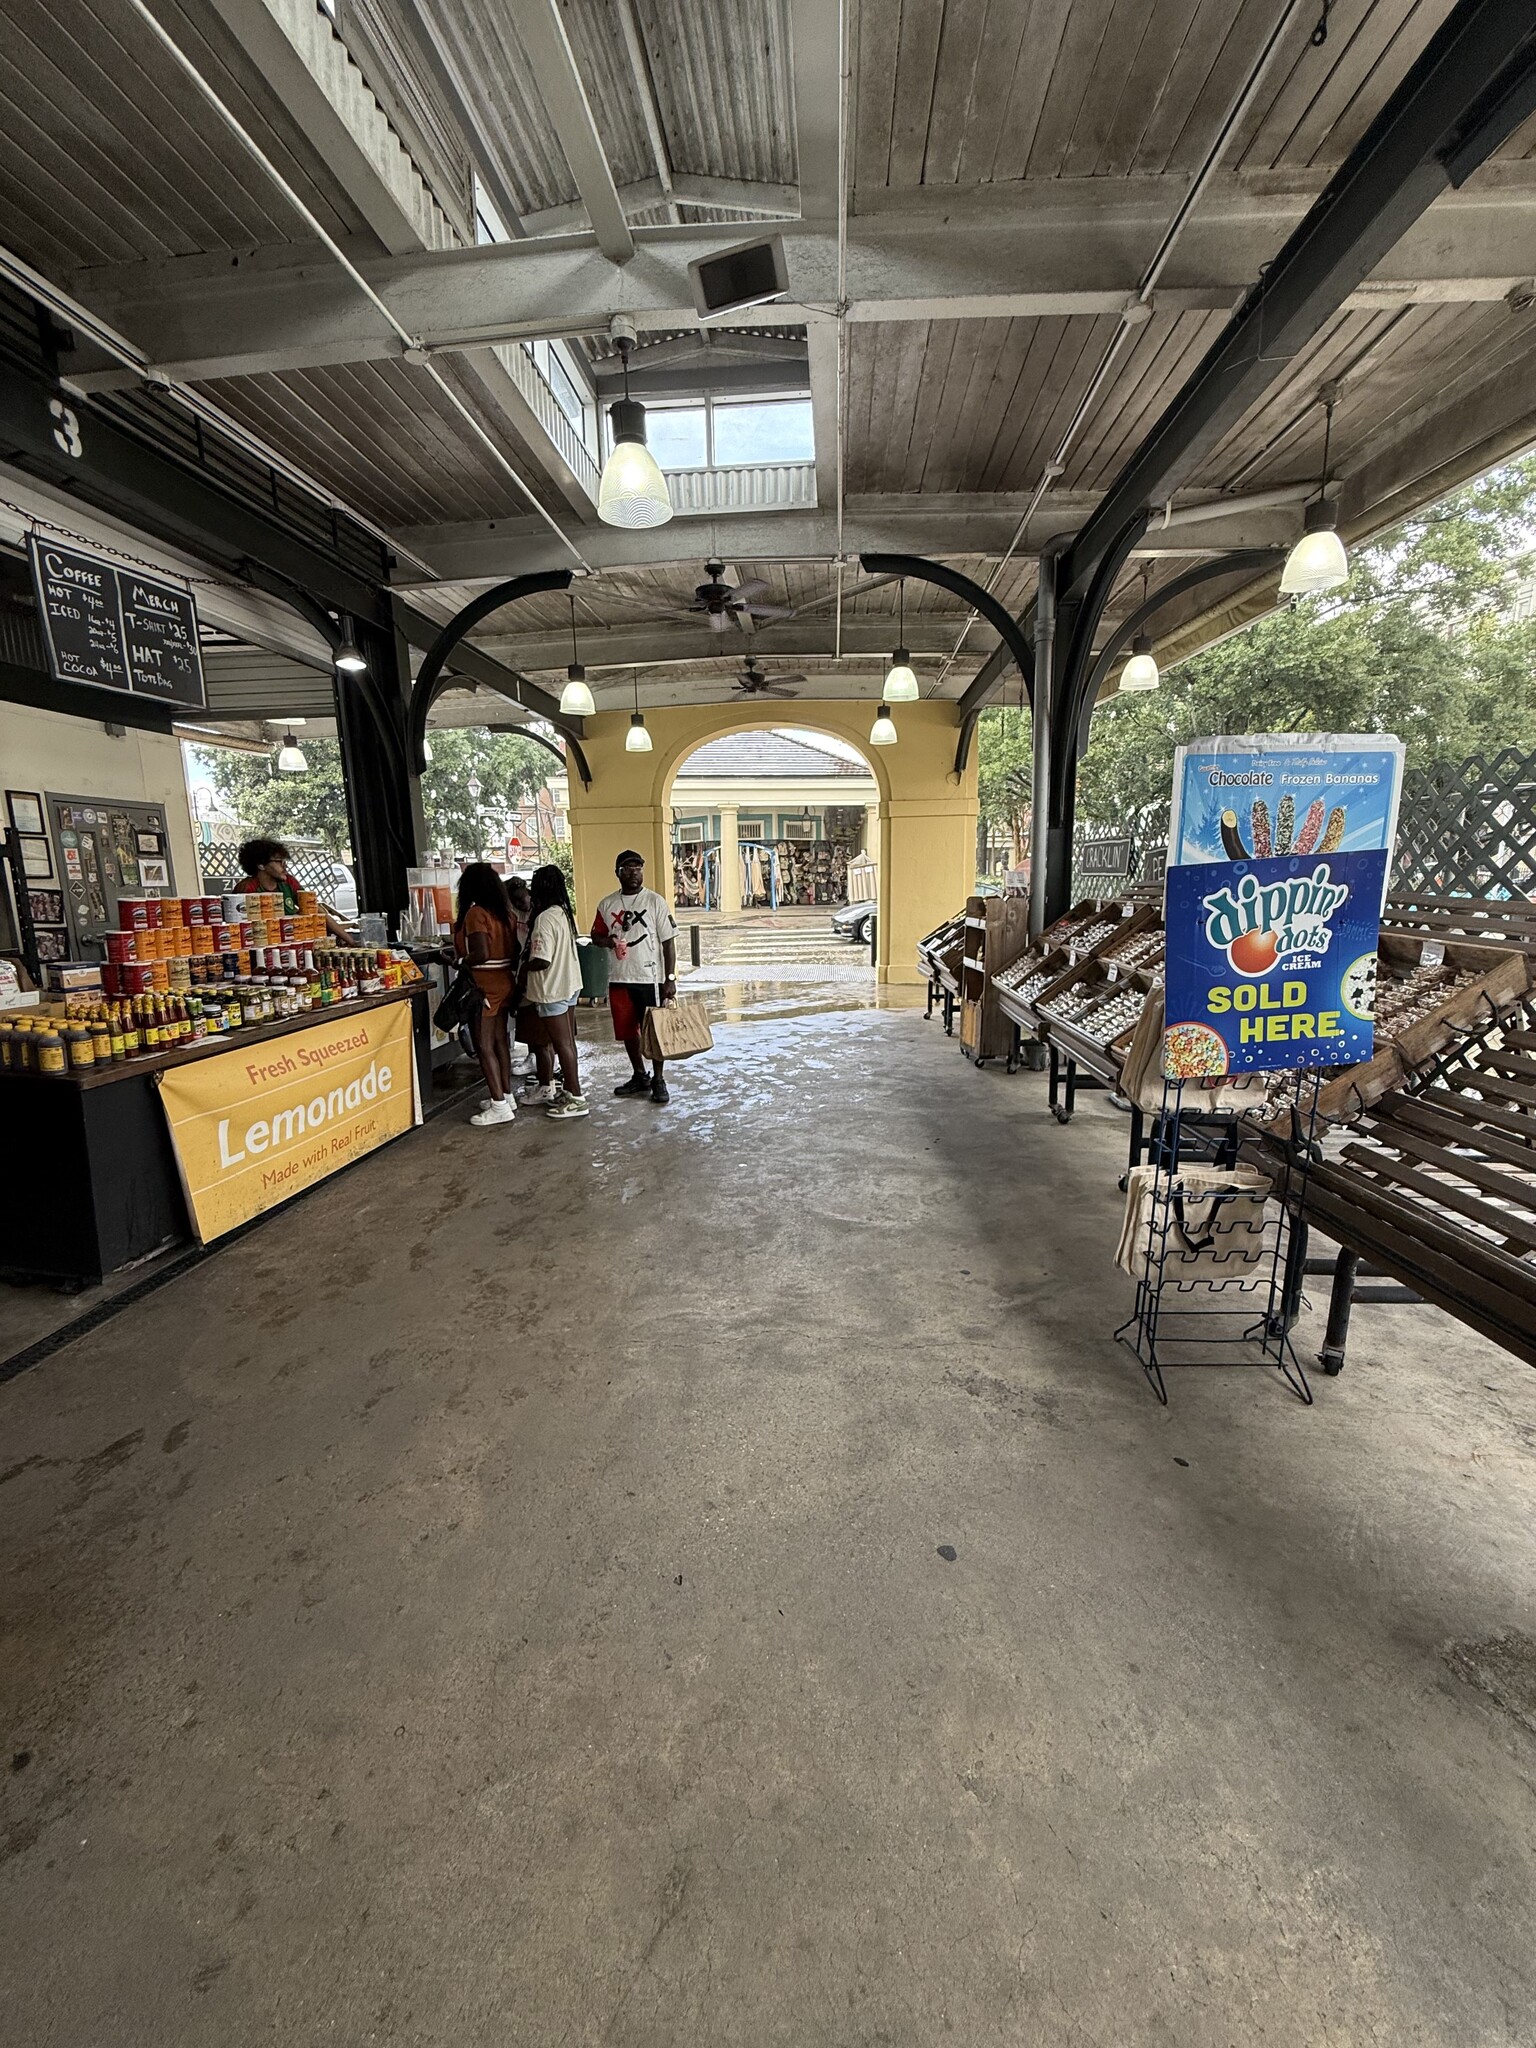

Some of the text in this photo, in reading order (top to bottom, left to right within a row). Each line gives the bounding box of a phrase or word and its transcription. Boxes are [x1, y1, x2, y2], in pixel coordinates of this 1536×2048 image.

[49, 399, 83, 458] 3
[47, 584, 73, 600] HOT
[49, 602, 80, 620] ICED
[124, 612, 188, 640] T-SHIRT $25
[60, 650, 81, 662] HOT
[63, 662, 98, 677] COCOA
[132, 645, 192, 674] HAT $25
[1208, 770, 1379, 787] Chocolate Frozen Bananas
[1085, 845, 1125, 869] CRACKLIN'
[1207, 866, 1345, 948] dippin'
[1276, 924, 1330, 953] dots
[1281, 962, 1322, 971] CREAM
[1292, 954, 1312, 962] ICE
[1207, 981, 1307, 1014] SOLD
[245, 1028, 370, 1085] Fresh Squeezed
[218, 1060, 393, 1169] Lemonade
[262, 1119, 377, 1189] Made with Real Fruit
